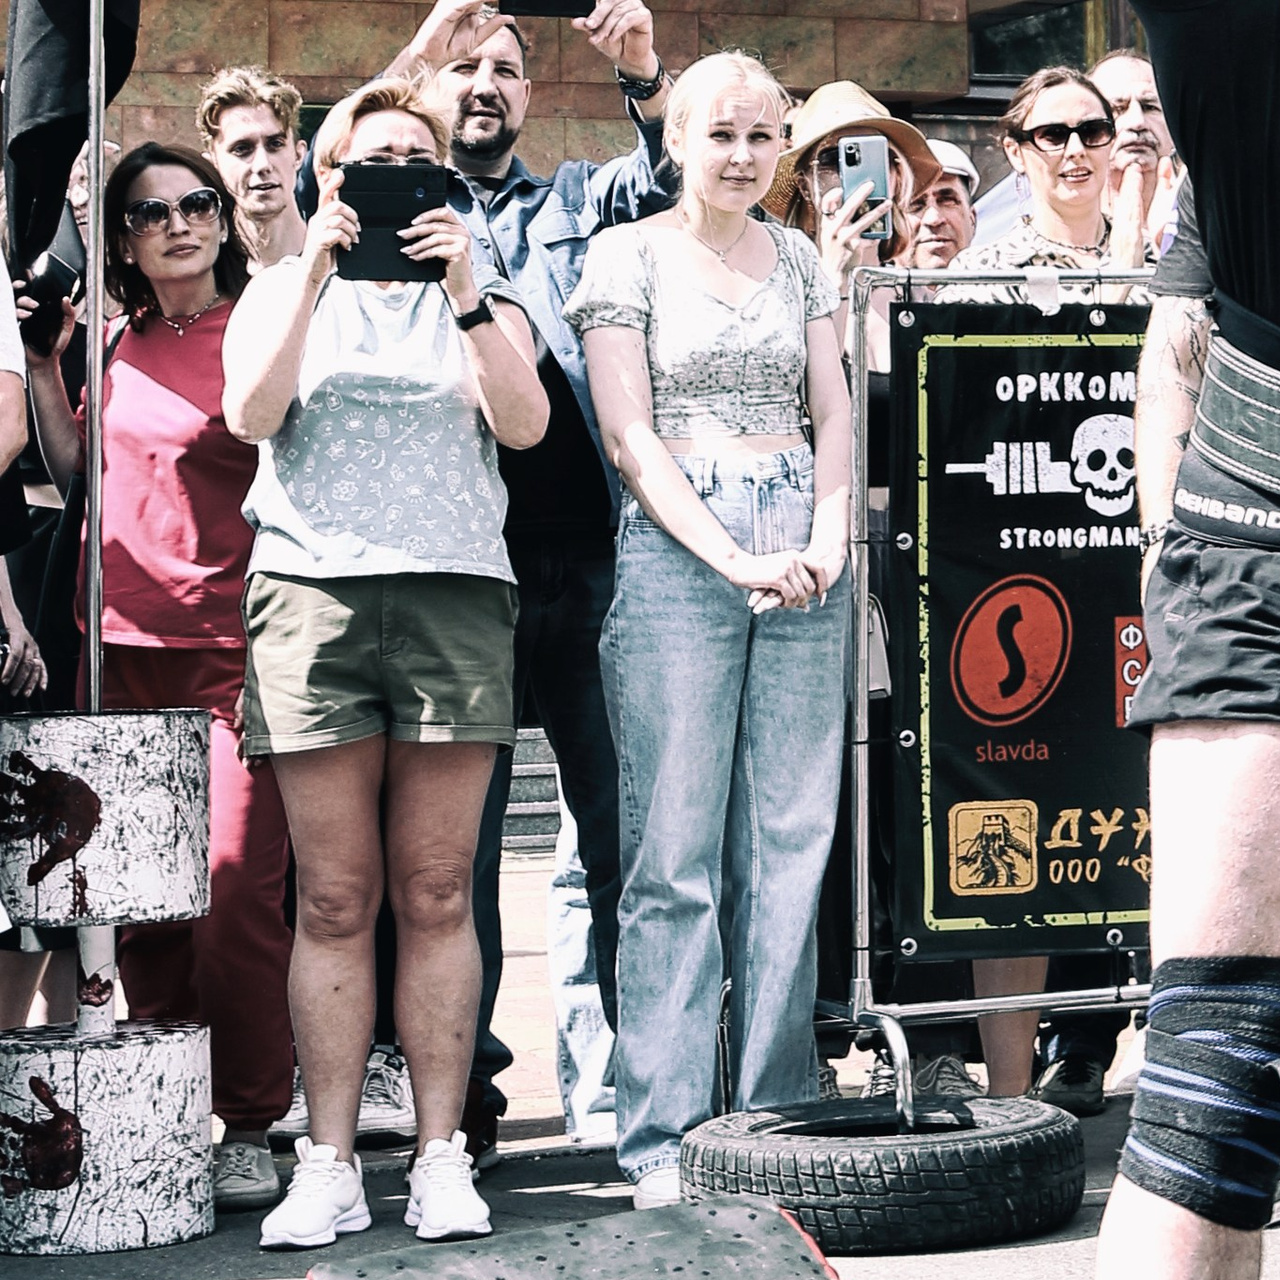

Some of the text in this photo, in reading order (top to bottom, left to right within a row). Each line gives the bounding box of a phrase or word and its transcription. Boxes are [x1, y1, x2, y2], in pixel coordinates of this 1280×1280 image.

[999, 525, 1140, 550] STRONGMAN
[975, 739, 1050, 763] slavda
[1049, 858, 1101, 884] ООО
